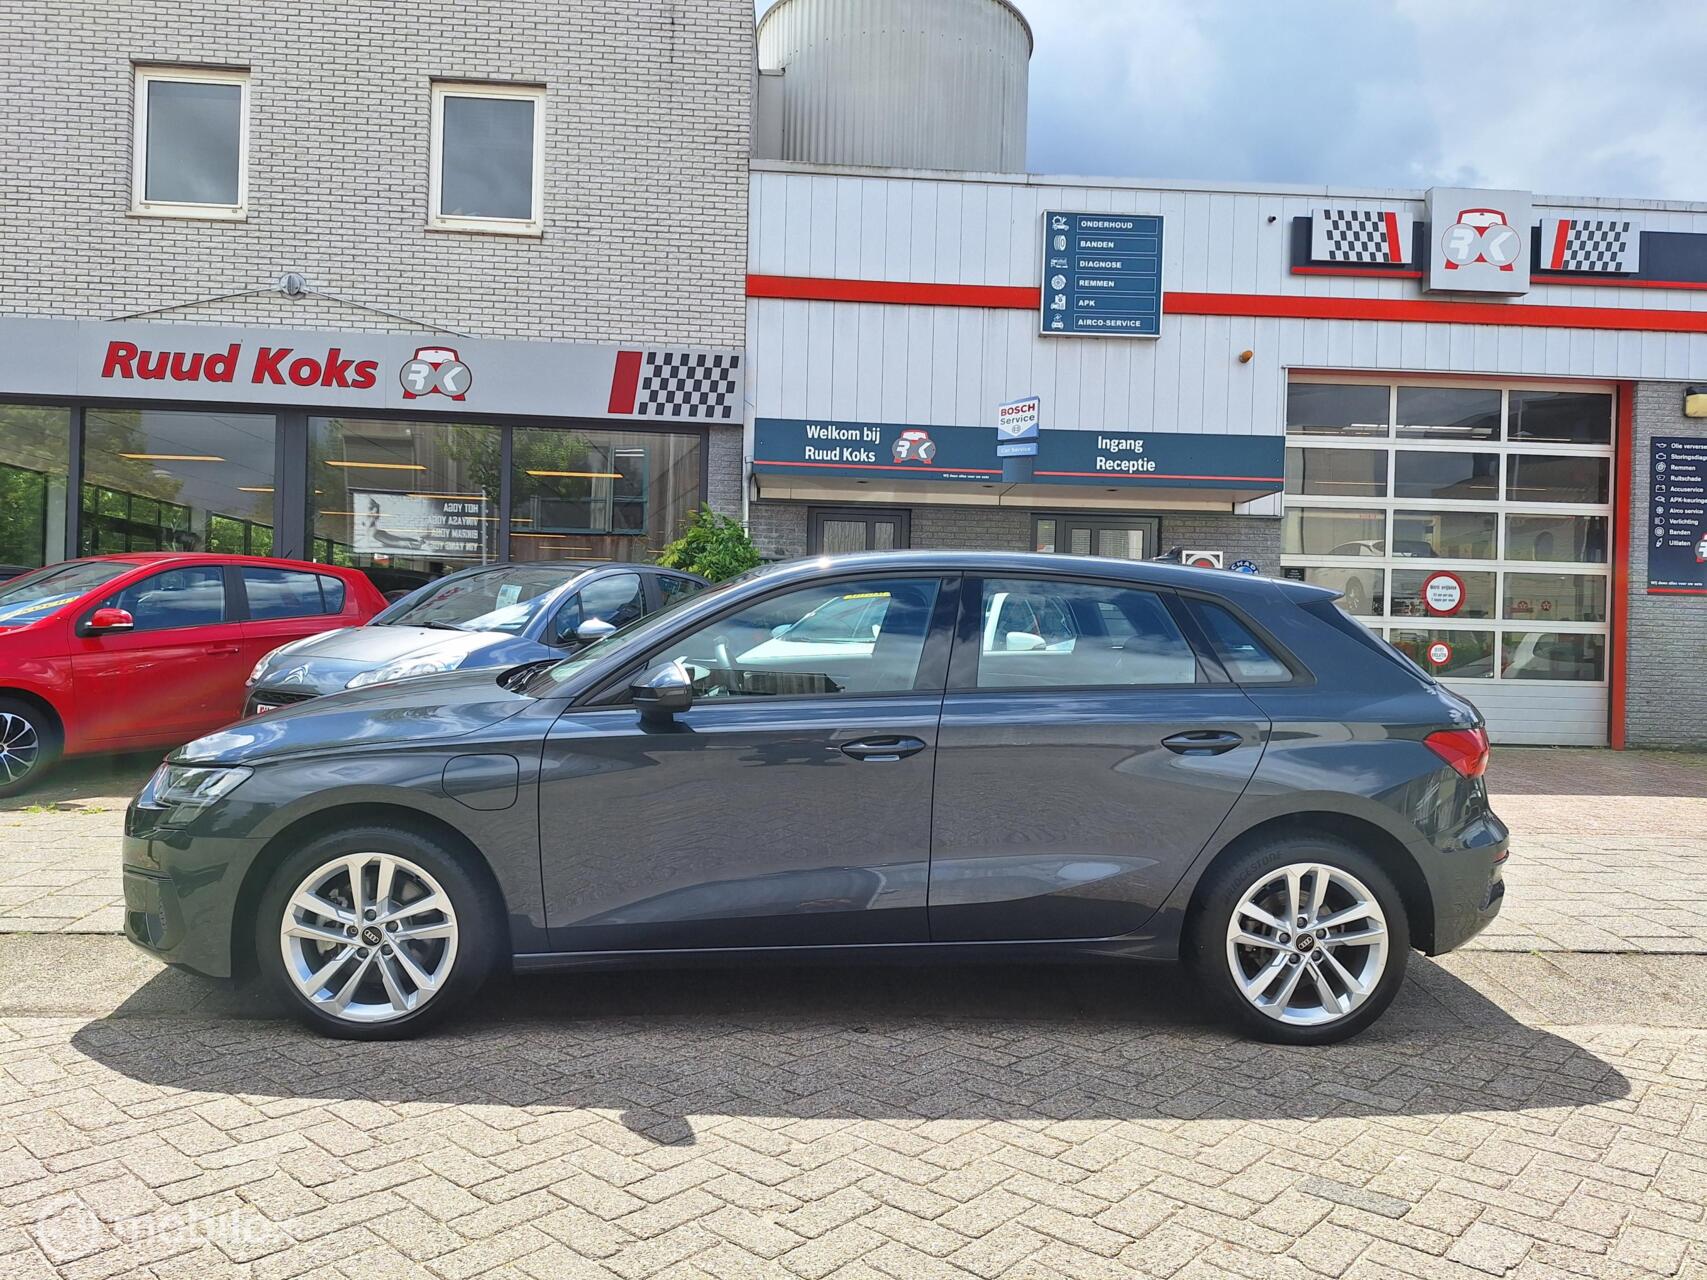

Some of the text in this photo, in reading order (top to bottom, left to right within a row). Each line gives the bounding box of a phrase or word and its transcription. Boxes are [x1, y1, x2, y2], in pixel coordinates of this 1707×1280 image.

[1081, 220, 1133, 229] ONDERHOUD
[1080, 240, 1114, 248] BANDEN
[1079, 261, 1122, 269] DIAGNOSE
[1079, 280, 1115, 288] REMMEN
[1078, 299, 1096, 307] APK
[1078, 318, 1141, 327] AIRCO-SERVICE
[101, 340, 379, 390] Ruud Koks
[1000, 403, 1036, 417] BOSCH
[1000, 414, 1036, 426] Service
[806, 425, 881, 444] Welkom bij
[1097, 436, 1144, 453] Ingang
[805, 446, 876, 462] Ruud Koks
[1096, 456, 1156, 474] Receptie
[1669, 518, 1699, 526] Verlichting
